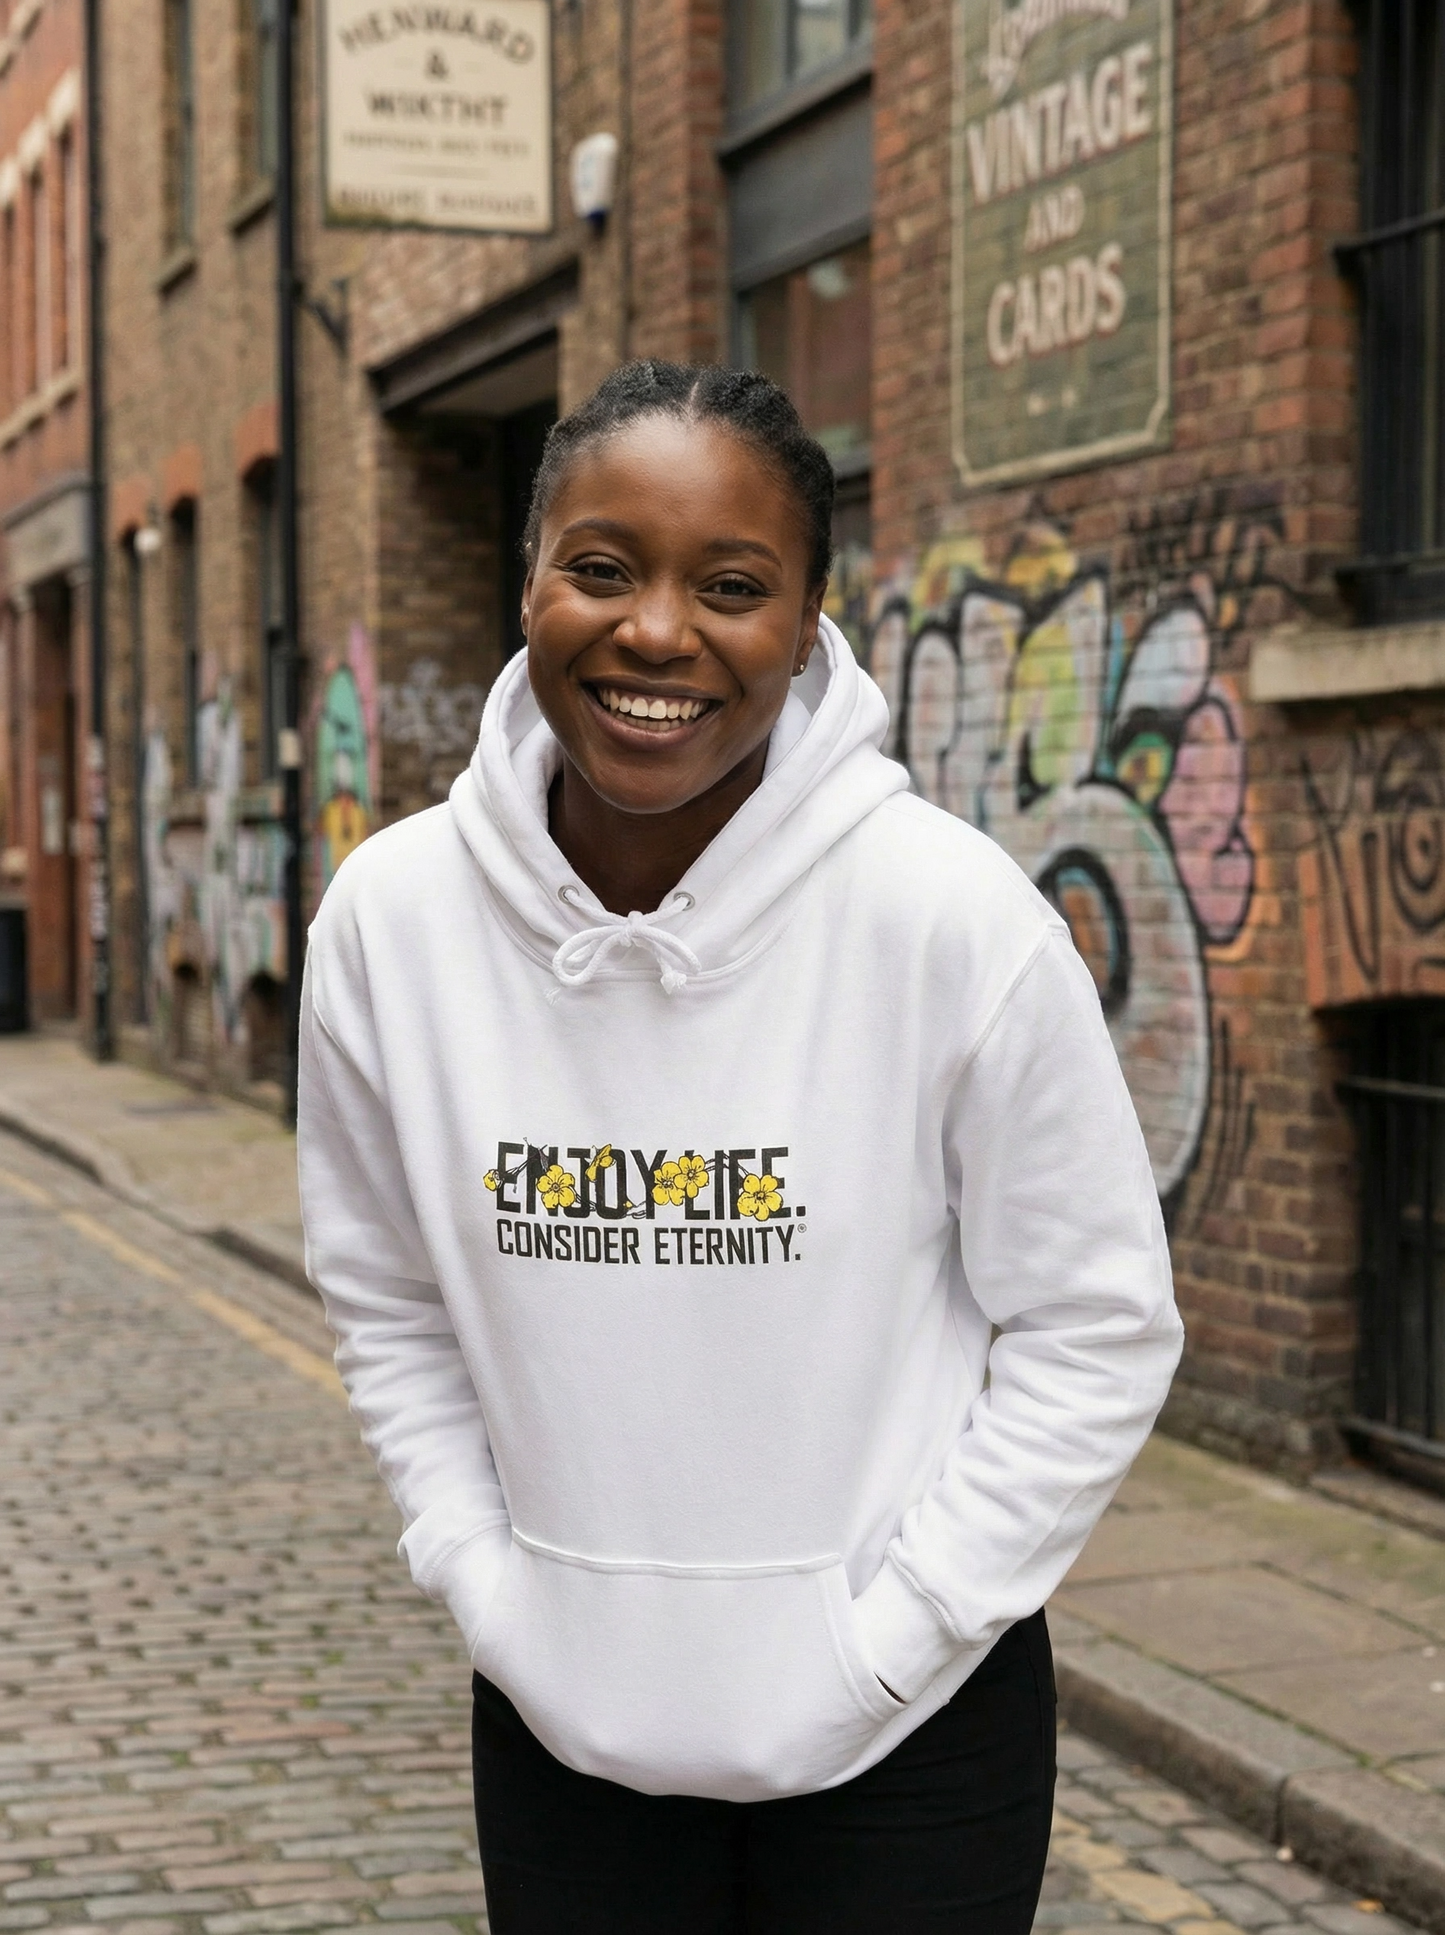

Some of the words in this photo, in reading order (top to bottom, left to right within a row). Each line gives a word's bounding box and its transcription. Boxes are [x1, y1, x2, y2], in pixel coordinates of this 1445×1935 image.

[966, 41, 1153, 206] VINTAGE
[1024, 184, 1086, 251] AND
[987, 241, 1126, 366] CARDS
[496, 1140, 667, 1220] ENJOY
[684, 1146, 806, 1220] LIFE.
[496, 1218, 641, 1264] CONSIDER
